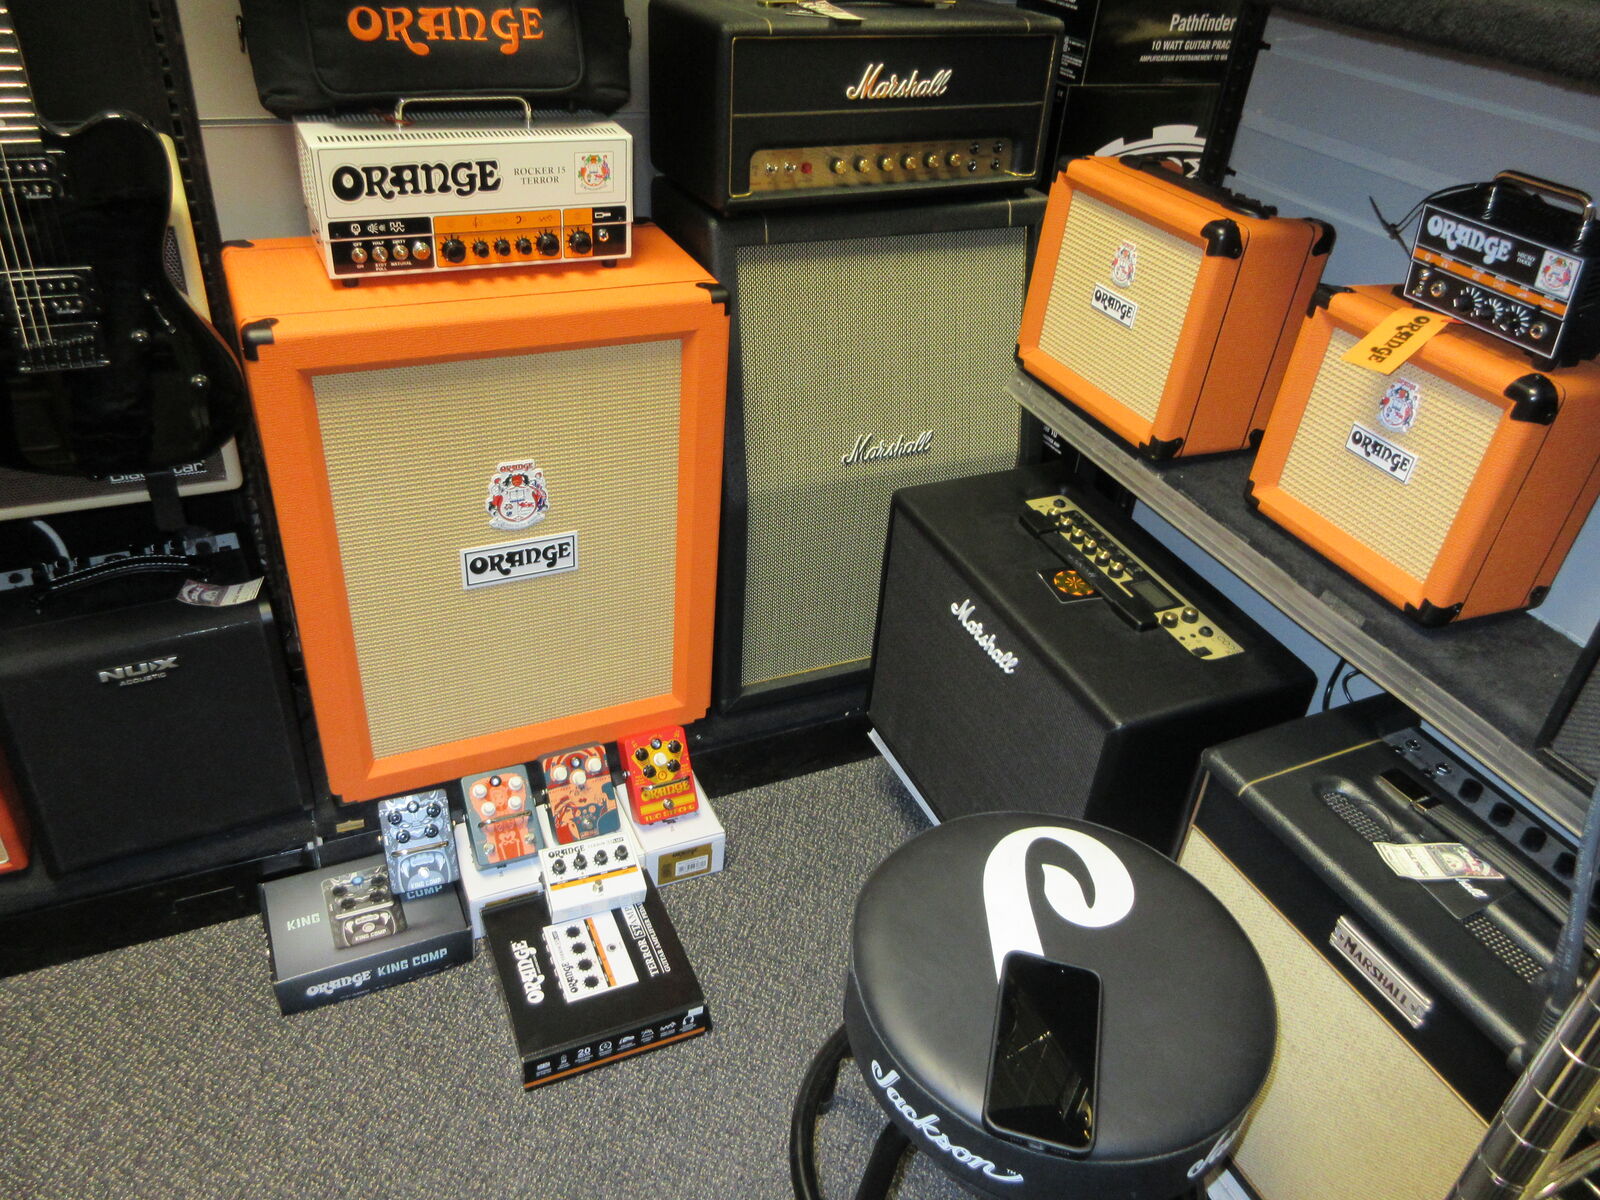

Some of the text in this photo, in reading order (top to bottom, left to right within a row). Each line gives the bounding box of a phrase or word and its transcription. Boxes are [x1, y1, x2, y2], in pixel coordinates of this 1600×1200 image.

[346, 5, 545, 56] ORANGE
[1169, 13, 1238, 32] Pathfinder
[1151, 40, 1232, 51] 10 WATT GUITAR PRAC
[846, 62, 952, 100] Marshall
[331, 159, 502, 202] ORANGE
[513, 165, 567, 176] ROCKER 15
[520, 175, 560, 185] TERROR
[1426, 214, 1513, 265] ORANGE
[1094, 288, 1133, 321] ORANGE
[1367, 315, 1431, 363] ORANGE
[841, 429, 935, 466] Marshall
[1351, 430, 1411, 473] ORANGE
[468, 541, 572, 576] ORANGE
[950, 598, 1019, 674] Marshall
[97, 655, 180, 684] NUX
[119, 671, 168, 687] ACOUSTIC
[640, 780, 691, 802] ORANGE
[547, 844, 586, 859] ORANGE
[286, 912, 321, 932] KING
[355, 932, 371, 942] KING
[306, 969, 373, 997] ORANGE
[377, 959, 409, 977] KING
[412, 947, 449, 967] COMP
[510, 940, 546, 1004] ORANGE
[637, 937, 660, 977] TERROR
[656, 948, 672, 973] GUITAR
[1343, 937, 1408, 1005] MARSHALL
[561, 961, 579, 994] ORANGE
[871, 1059, 1024, 1183] Jackson
